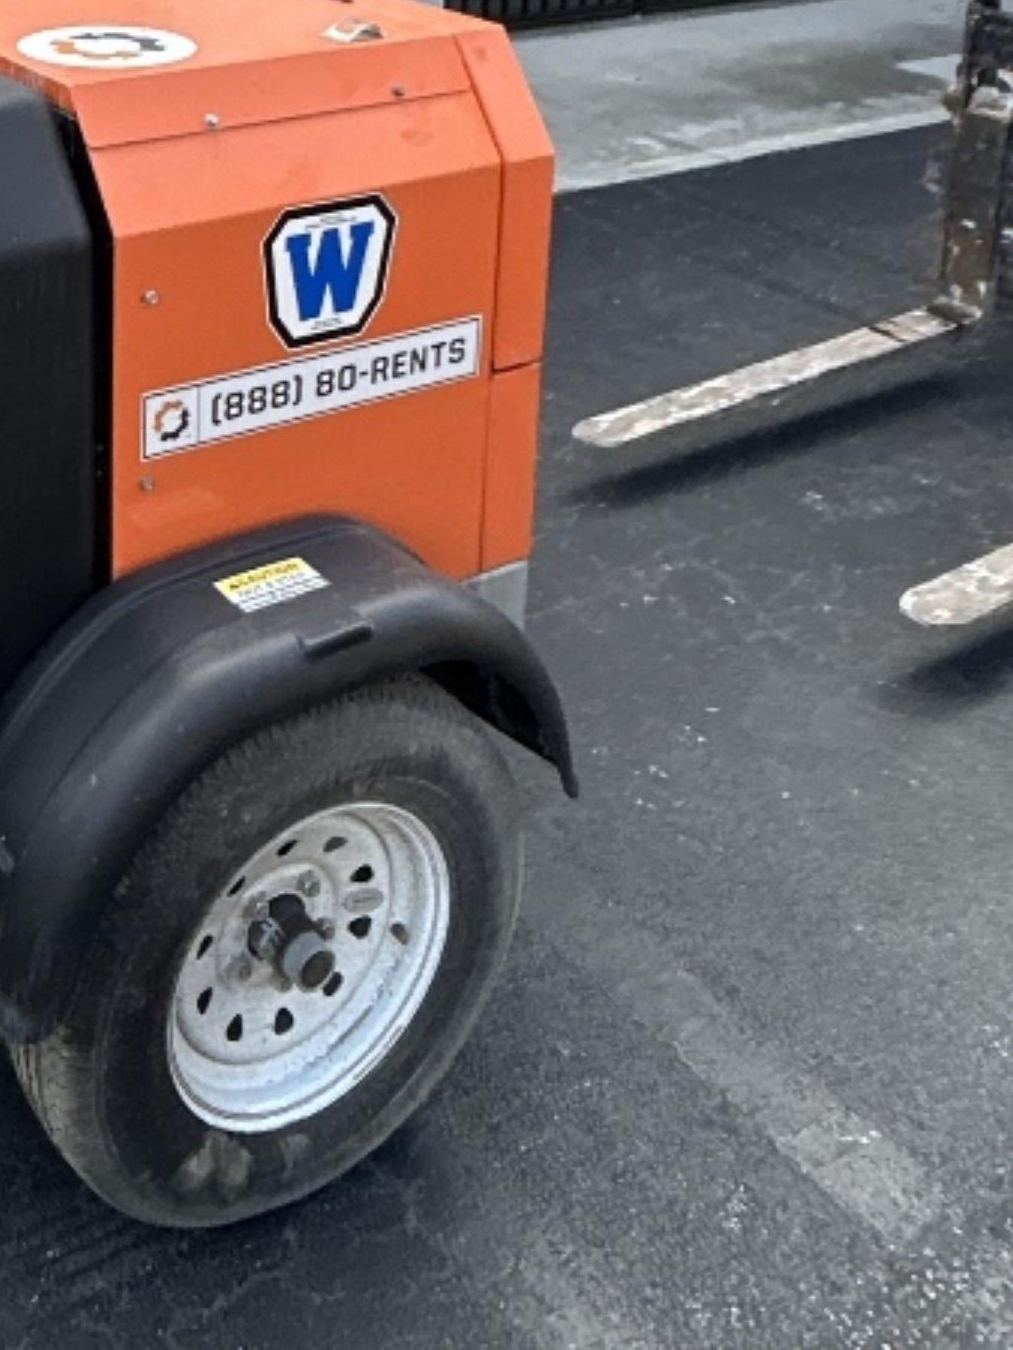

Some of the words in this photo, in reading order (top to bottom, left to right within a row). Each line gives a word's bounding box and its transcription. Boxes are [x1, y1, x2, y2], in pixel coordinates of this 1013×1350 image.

[285, 220, 375, 322] W
[211, 374, 303, 426] (888)
[316, 338, 466, 398] 80-RENTS
